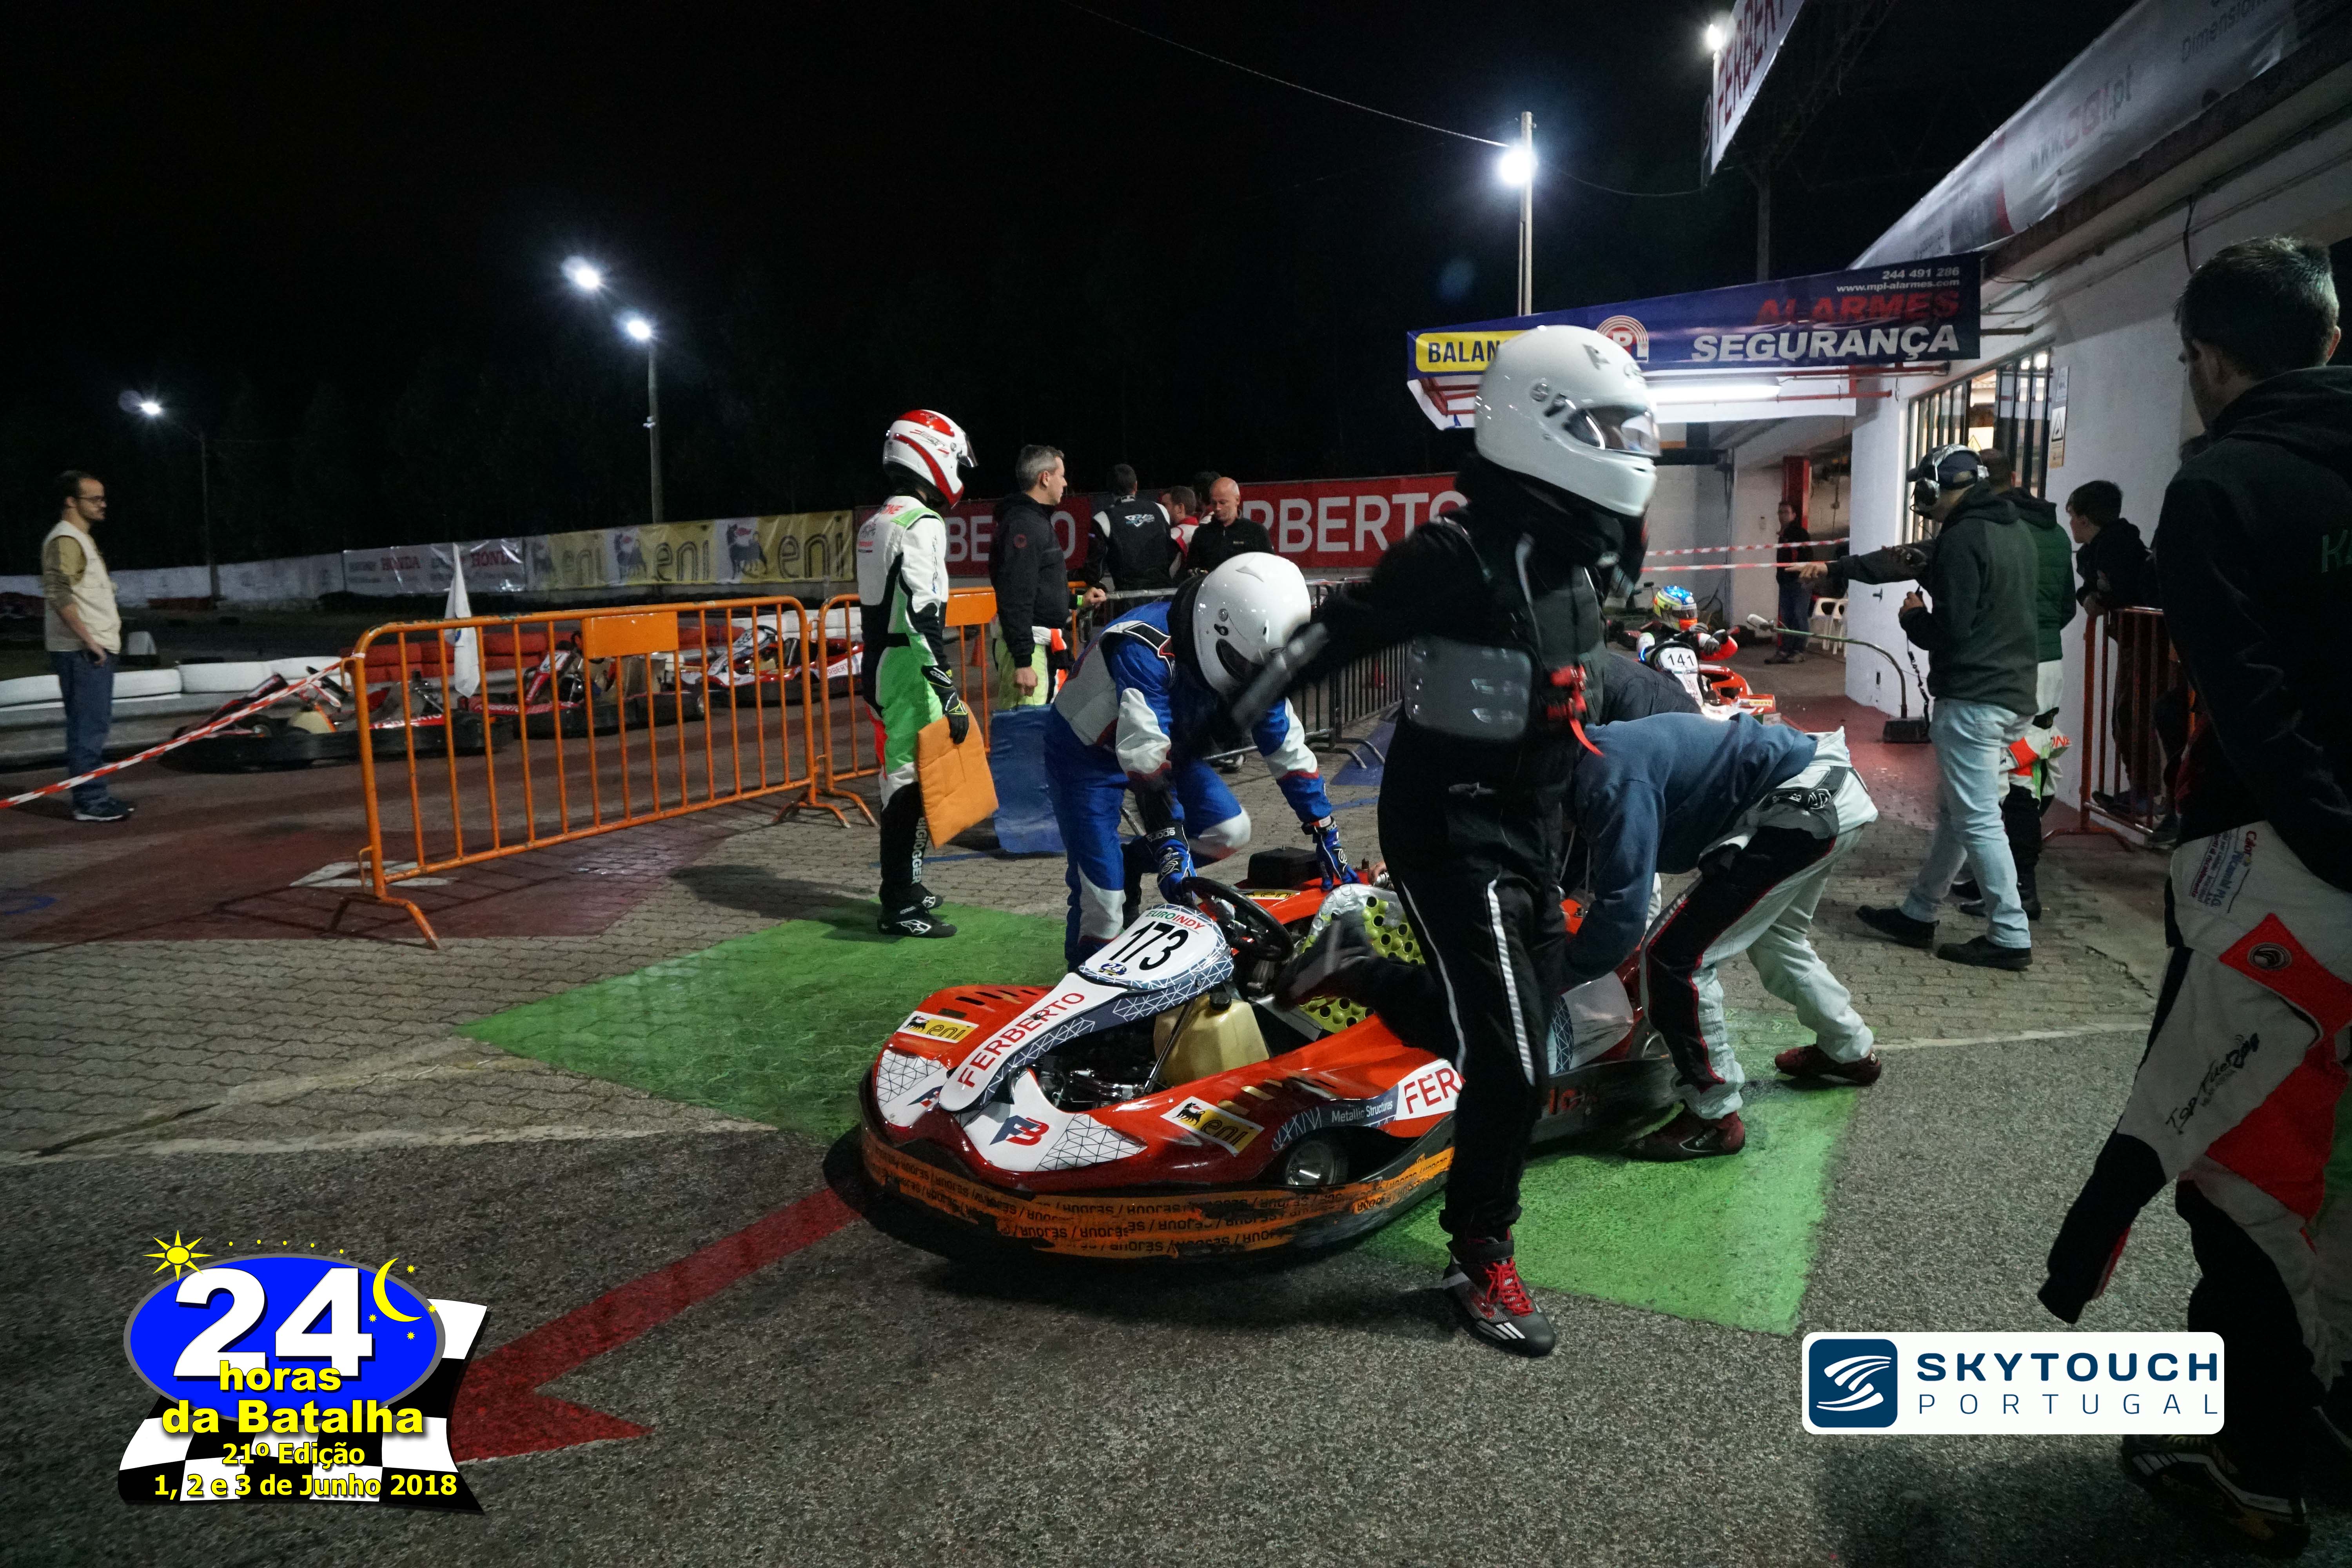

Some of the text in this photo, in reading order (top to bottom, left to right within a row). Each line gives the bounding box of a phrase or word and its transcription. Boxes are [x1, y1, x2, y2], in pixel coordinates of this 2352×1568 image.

[1717, 0, 1783, 144] FERBER
[1837, 278, 1960, 293] www.mpl-alarmes.com
[1882, 266, 1960, 280] 244 491 286
[1755, 290, 1960, 325] ALARMES
[1428, 338, 1501, 363] BALAN
[1691, 324, 1959, 362] SEGURANÇA
[1242, 490, 1468, 553] RBERT
[470, 550, 510, 567] HOND
[1668, 653, 1694, 666] 141
[1145, 910, 1205, 930] EUROINDY
[1108, 921, 1189, 971] 173
[926, 1024, 972, 1041] eni
[957, 992, 1085, 1088] FERBERTO
[1404, 1067, 1465, 1114] FER
[1331, 1099, 1394, 1124] Metallic Structures
[1202, 1114, 1252, 1145] eni
